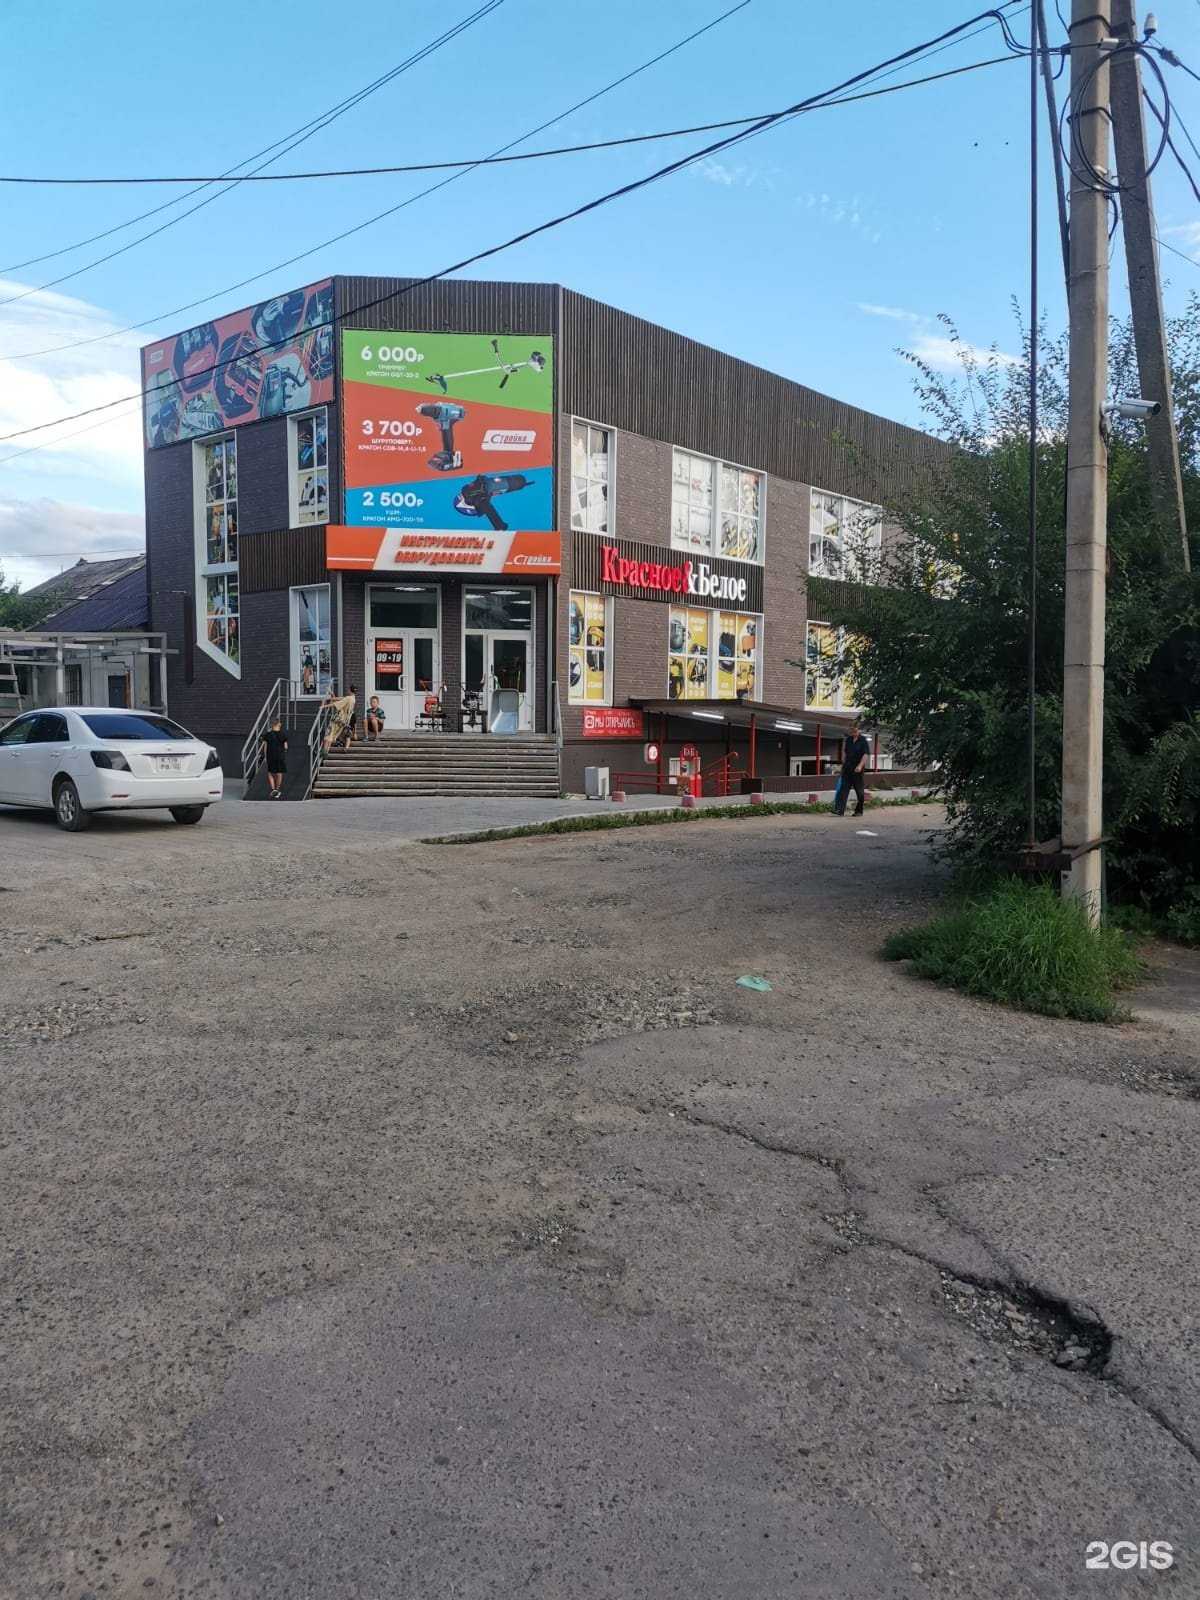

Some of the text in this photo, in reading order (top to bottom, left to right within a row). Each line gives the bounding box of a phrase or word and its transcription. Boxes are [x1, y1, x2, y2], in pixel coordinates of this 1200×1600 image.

[361, 345, 373, 361] 6
[362, 419, 374, 435] 3
[362, 491, 375, 506] 2
